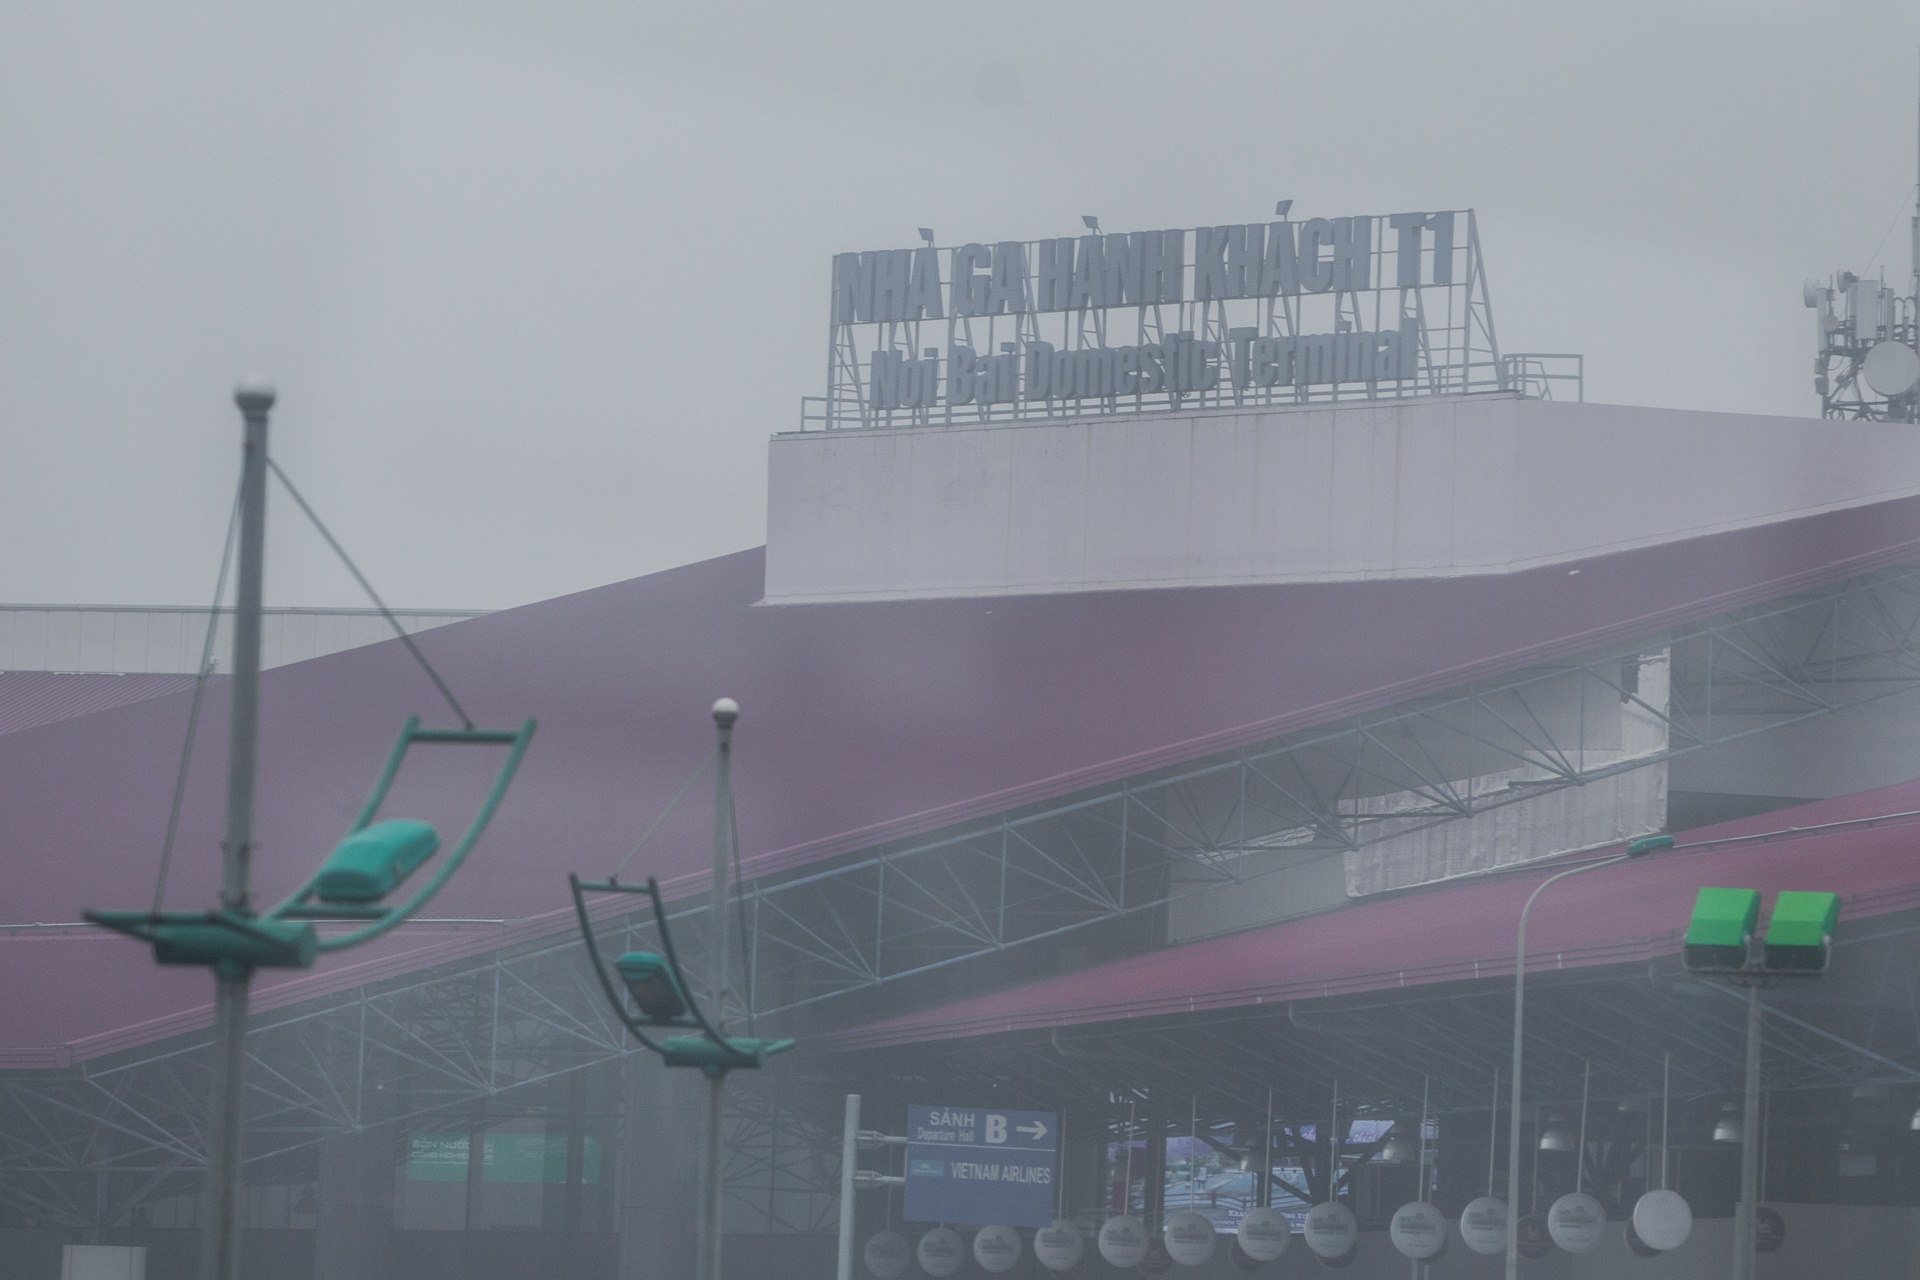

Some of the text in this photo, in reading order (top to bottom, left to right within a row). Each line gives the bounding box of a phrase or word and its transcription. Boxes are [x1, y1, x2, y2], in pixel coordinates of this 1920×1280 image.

[954, 242, 1029, 316] GA
[1194, 200, 1372, 300] KHÁCH
[1389, 210, 1454, 287] T1
[870, 316, 1419, 409] Noi Bai Domestic Terminal
[916, 1126, 975, 1143] Departure Hall
[929, 1107, 1008, 1144] SẢNH B
[950, 1161, 1052, 1185] VIETNAM AIRLINES
